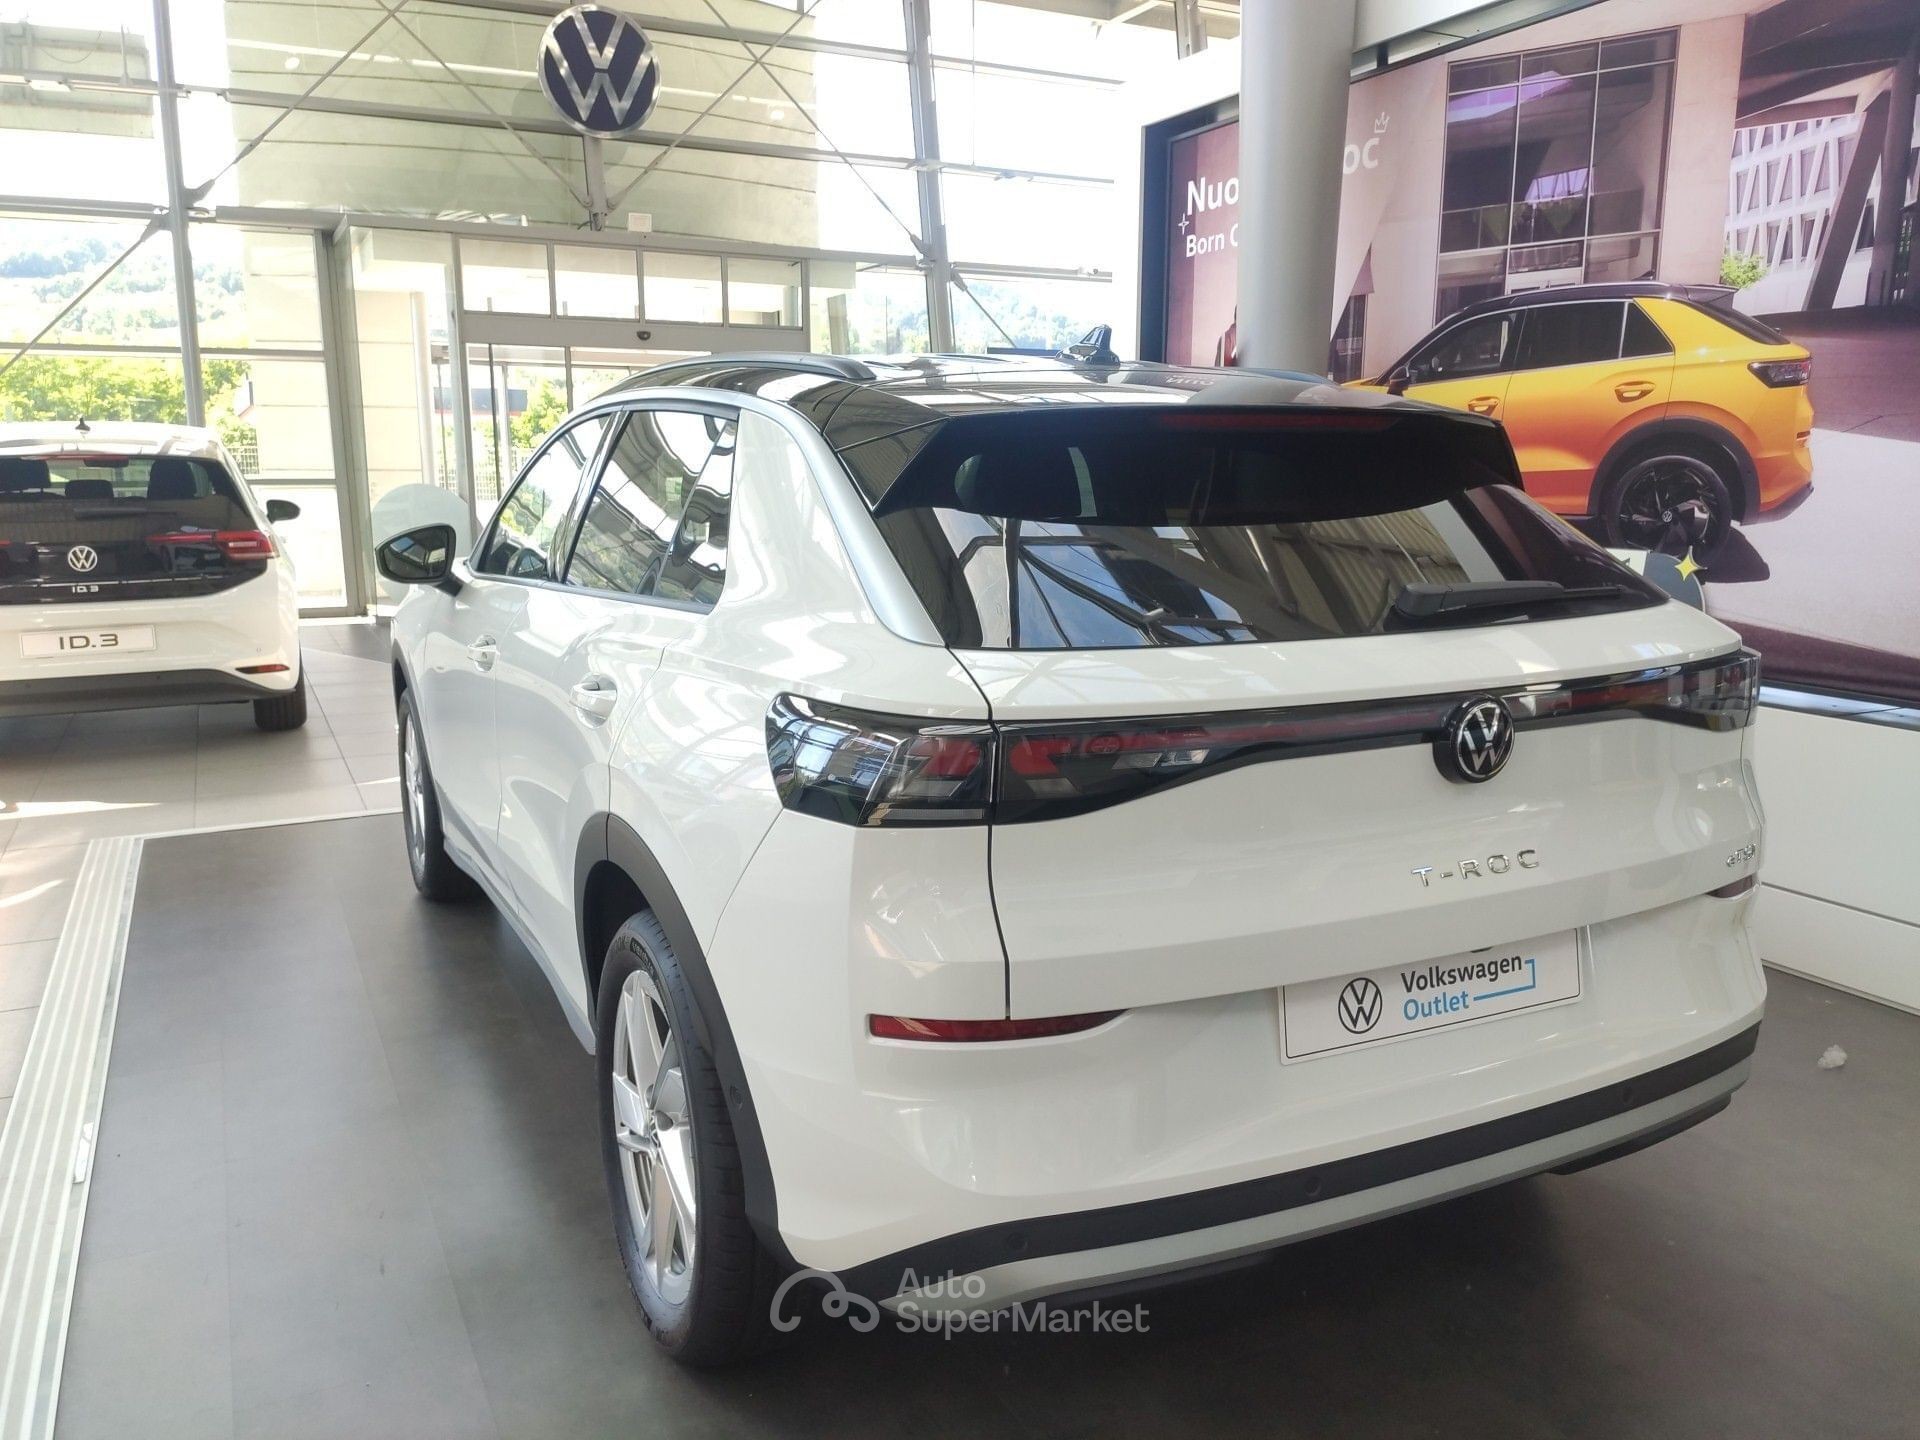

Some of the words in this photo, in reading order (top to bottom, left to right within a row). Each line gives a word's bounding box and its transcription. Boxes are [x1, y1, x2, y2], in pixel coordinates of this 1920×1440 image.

[538, 4, 660, 138] VW
[1187, 176, 1239, 216] Nuo
[1186, 233, 1225, 258] Born
[67, 545, 98, 572] VW
[59, 633, 119, 650] ID.3
[1457, 702, 1515, 778] VW
[1411, 849, 1540, 887] T-ROC
[1400, 954, 1523, 993] Volkswagen
[1338, 977, 1383, 1034] VW
[1403, 991, 1470, 1021] Outlet
